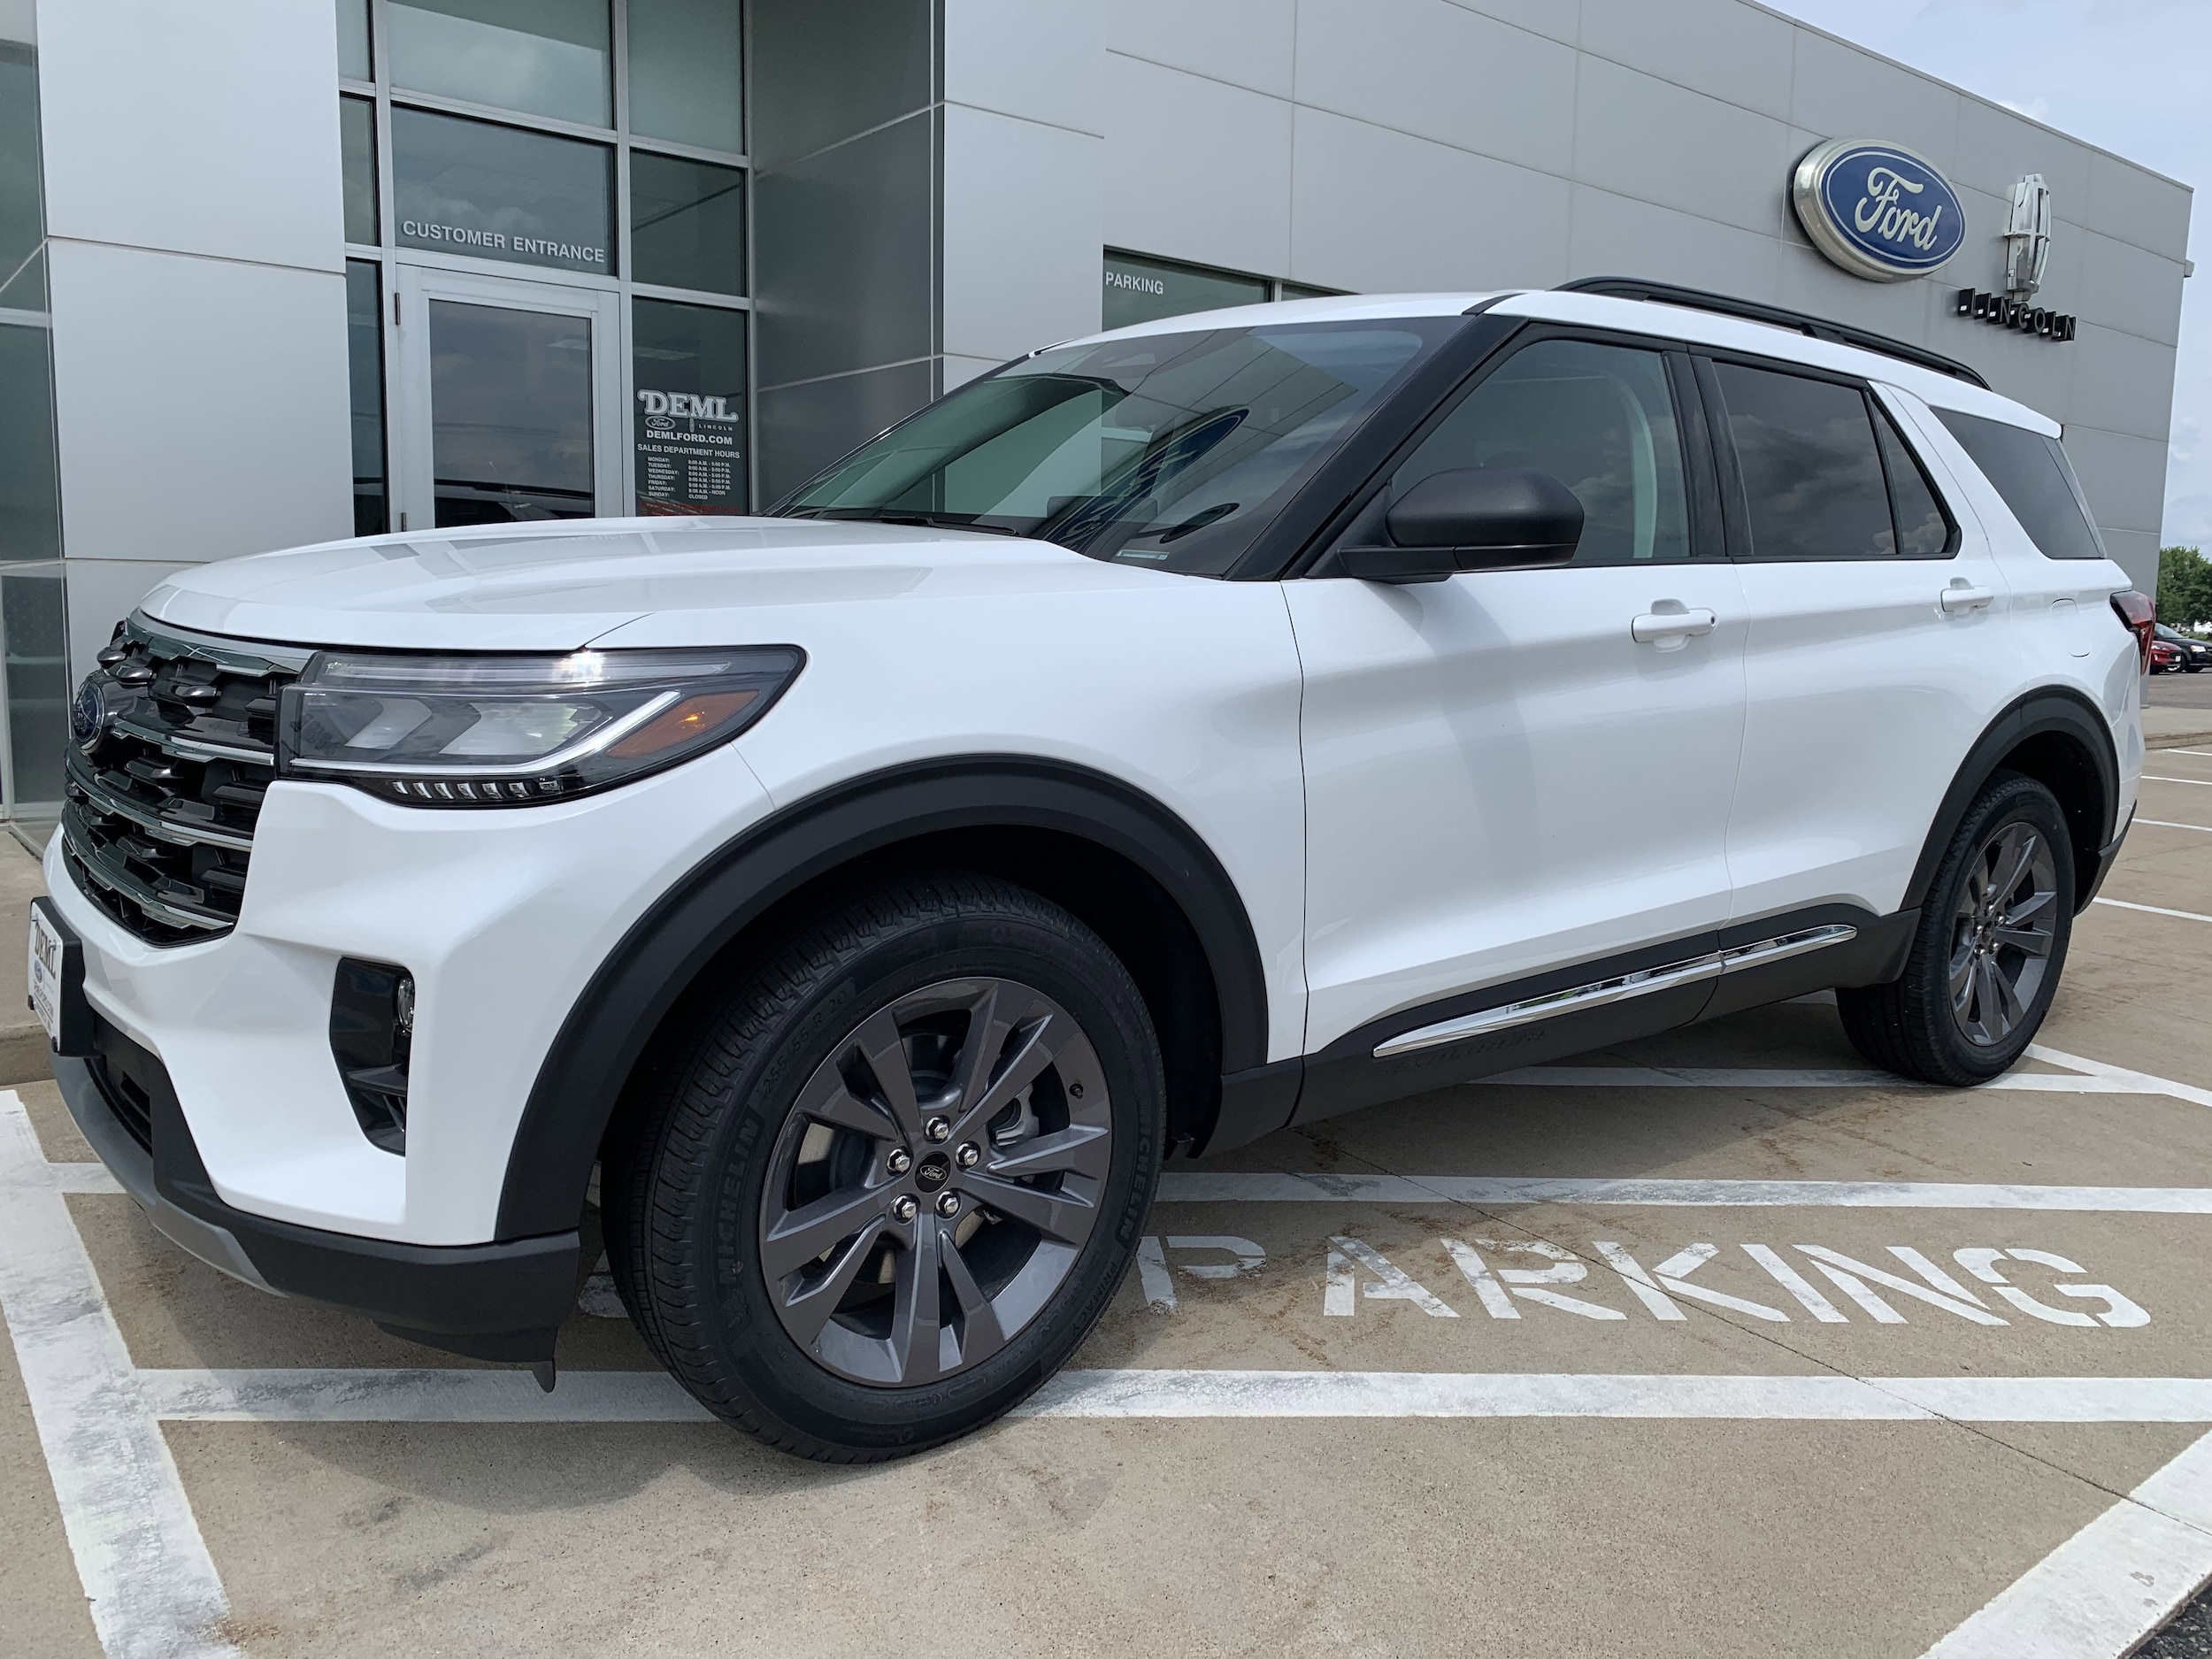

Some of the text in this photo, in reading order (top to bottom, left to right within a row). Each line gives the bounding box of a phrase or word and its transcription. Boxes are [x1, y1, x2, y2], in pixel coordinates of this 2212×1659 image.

[1855, 166, 1942, 252] Ford
[403, 220, 605, 263] CUSTOMER ENTRANCE
[1105, 271, 1164, 295] PARKING
[1958, 288, 2077, 342] LINCOLN
[637, 389, 739, 422] DEML
[646, 429, 733, 445] DEMLFORD.COM
[698, 423, 733, 432] LINCOLN
[637, 443, 741, 459] SALES DEPARTMENT HOURS
[1120, 1100, 1152, 1240] MICHELIN
[717, 1118, 759, 1284] MICHELIN
[1136, 1235, 2152, 1328] PARKING
